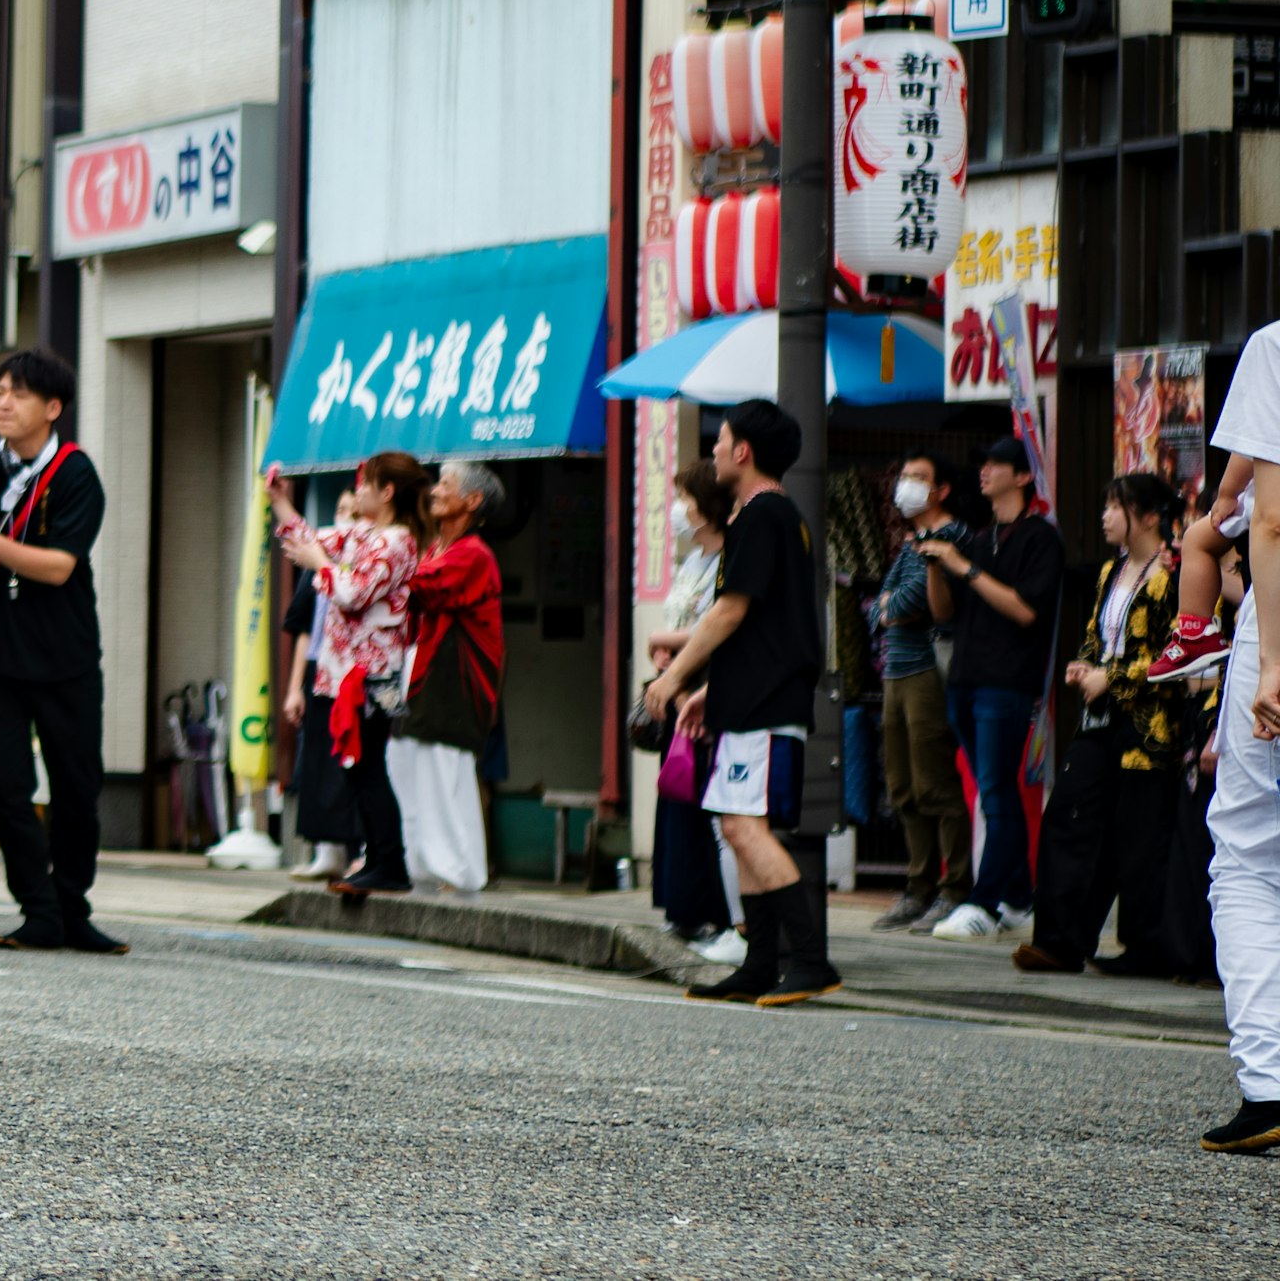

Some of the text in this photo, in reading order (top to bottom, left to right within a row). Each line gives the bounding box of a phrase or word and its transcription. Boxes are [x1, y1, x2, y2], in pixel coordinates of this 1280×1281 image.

[73, 126, 236, 233] くすりの中谷
[893, 51, 943, 255] 新町通り商店街
[308, 310, 552, 425] かくだ鮮魚店
